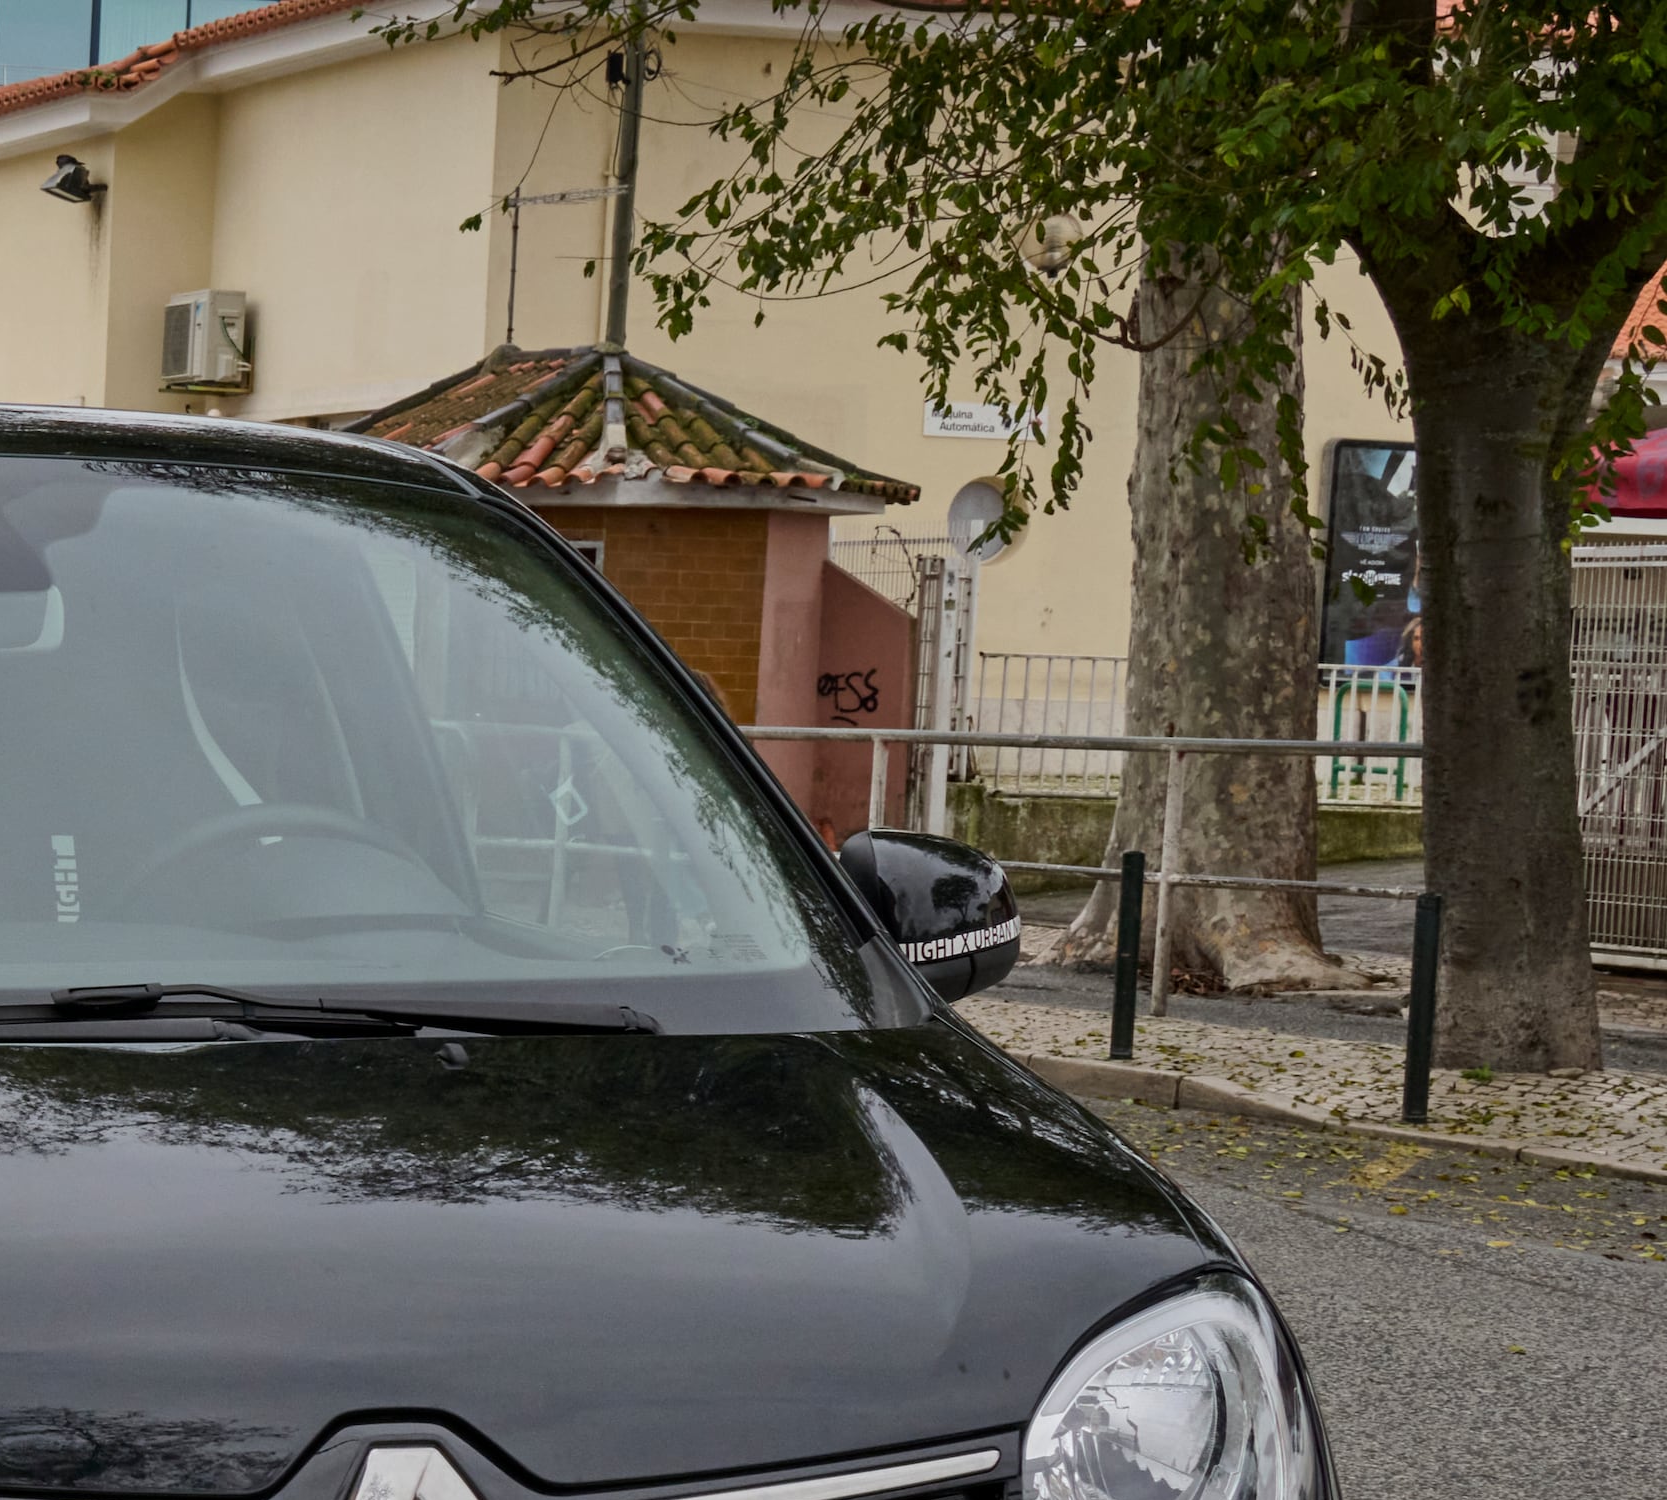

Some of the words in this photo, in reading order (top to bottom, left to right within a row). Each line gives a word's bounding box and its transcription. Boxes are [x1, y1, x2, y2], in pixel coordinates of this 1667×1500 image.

[939, 421, 995, 433] Automática
[961, 933, 971, 953] X
[974, 921, 1011, 949] URBAN
